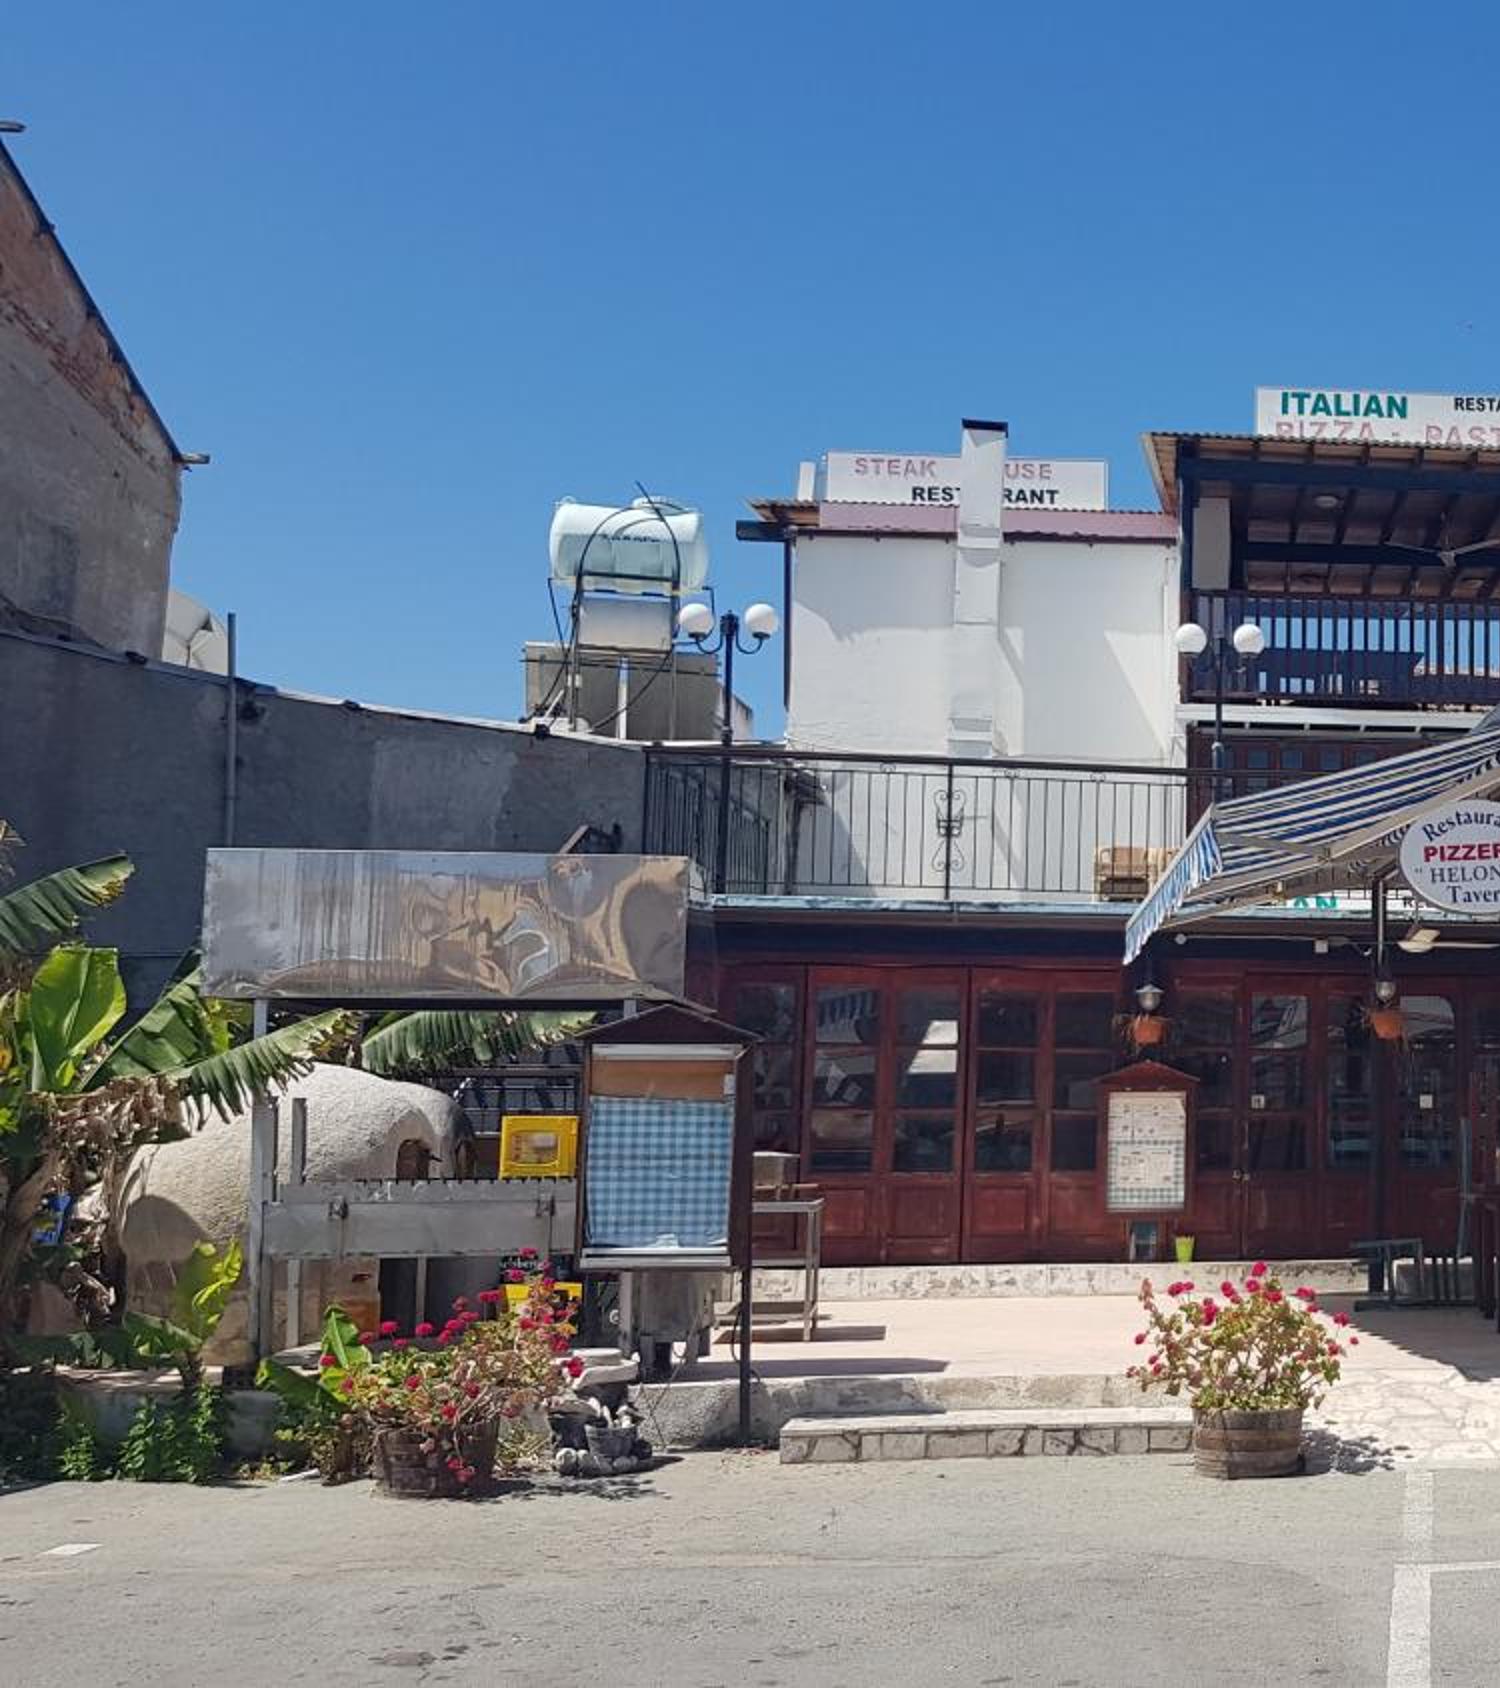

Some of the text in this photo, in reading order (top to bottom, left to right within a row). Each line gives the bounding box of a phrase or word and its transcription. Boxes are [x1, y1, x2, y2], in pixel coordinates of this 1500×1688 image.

[1281, 391, 1408, 419] ITALIAN
[1276, 421, 1376, 438] PIZZA
[854, 458, 1053, 480] STEAK USE
